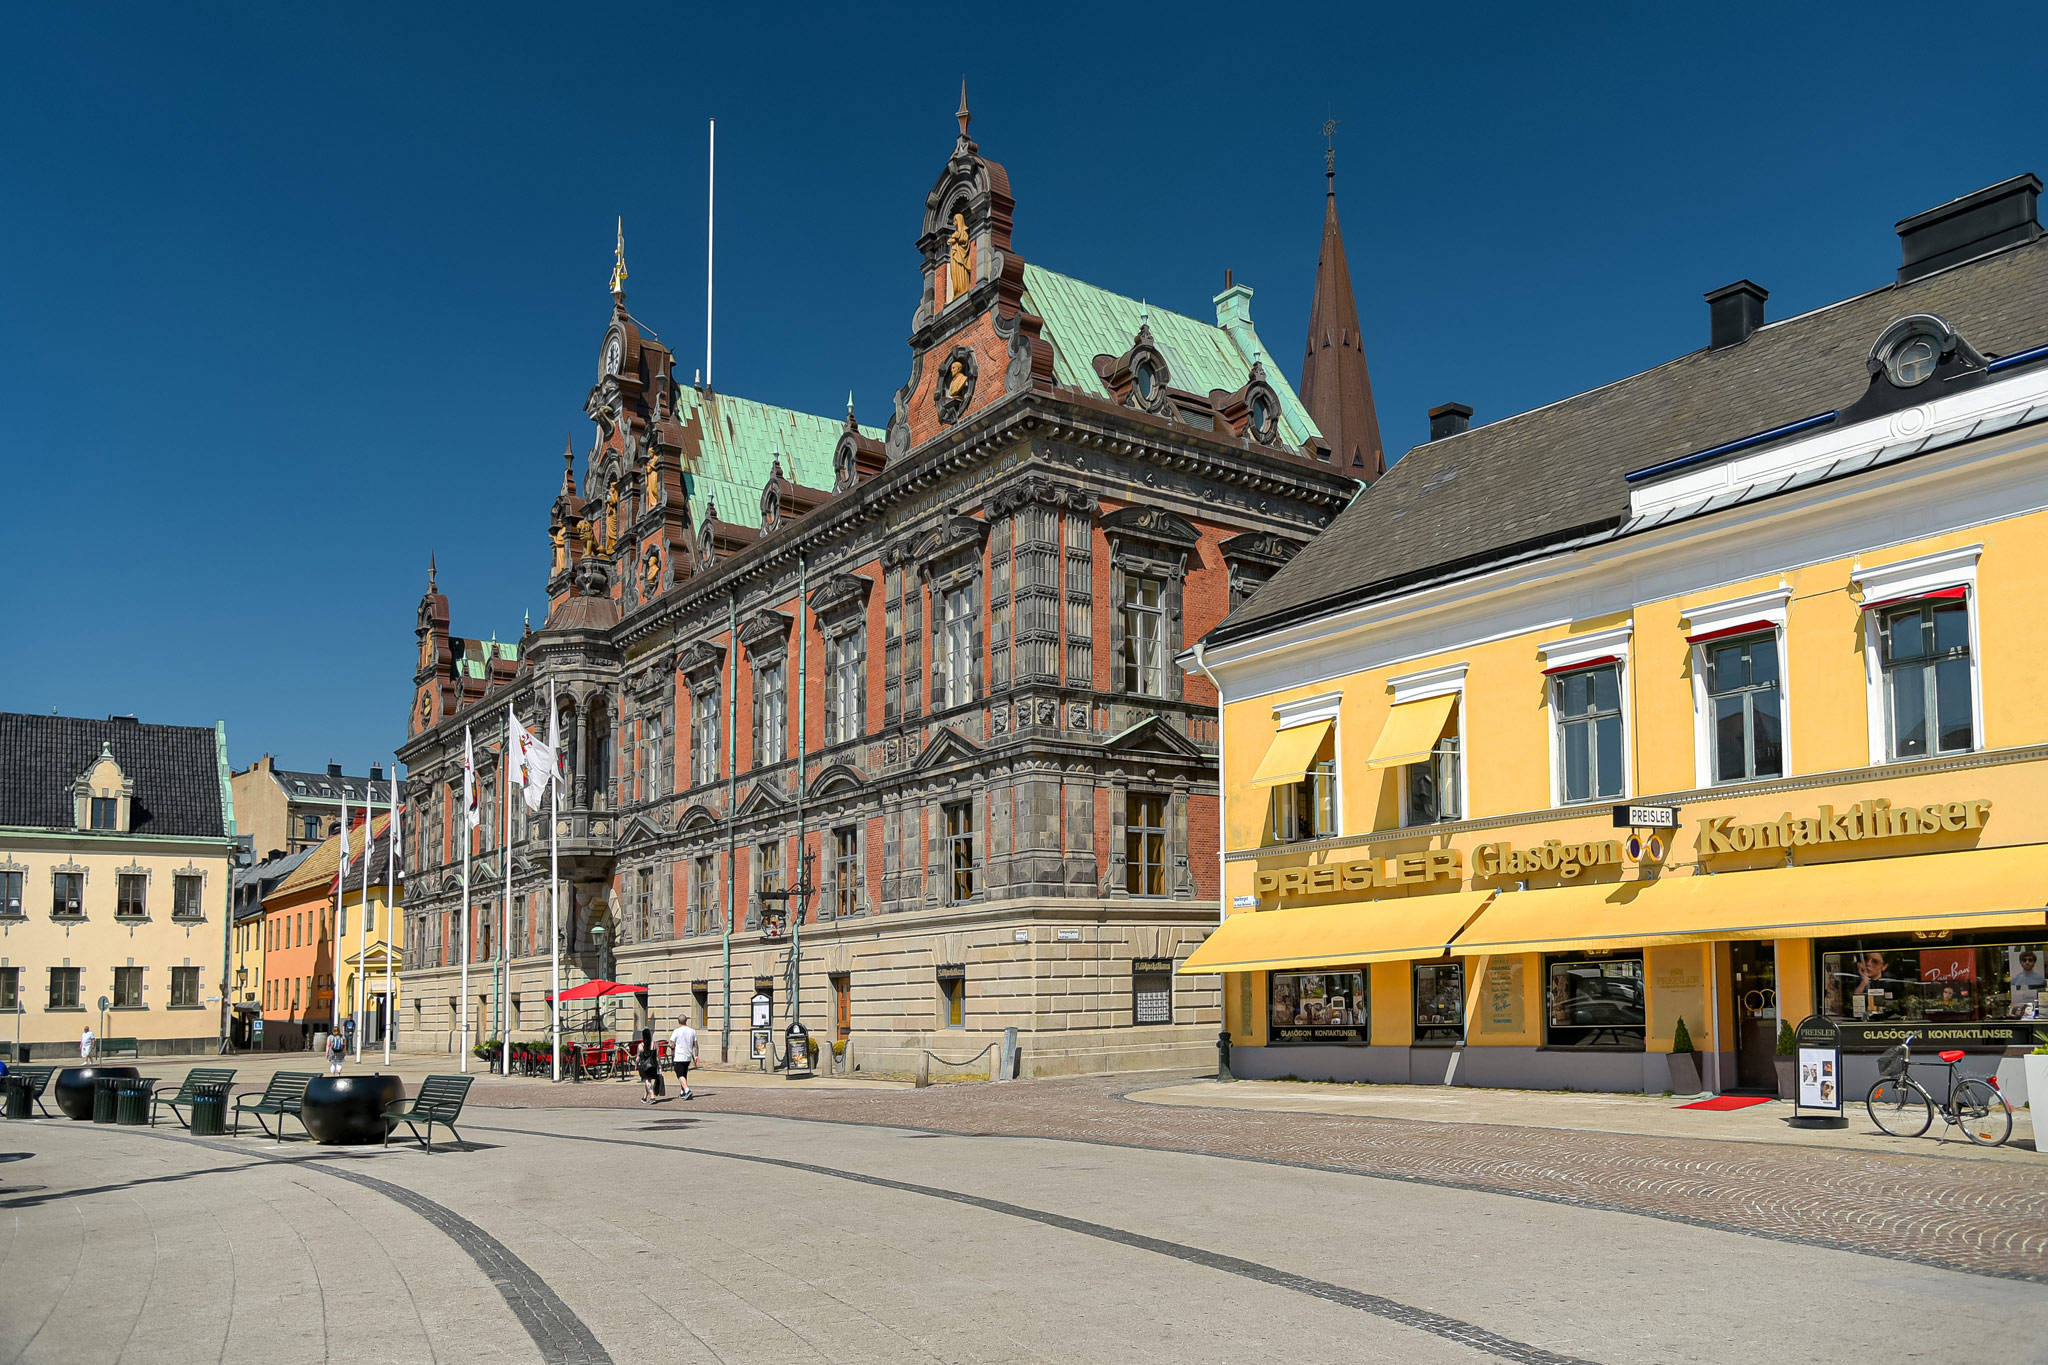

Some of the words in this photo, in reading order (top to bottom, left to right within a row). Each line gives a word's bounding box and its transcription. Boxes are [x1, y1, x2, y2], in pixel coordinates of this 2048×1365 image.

[977, 465, 994, 483] 1864
[1632, 808, 1671, 824] PREISLER
[1254, 849, 1463, 899] PREISLER
[1472, 839, 1624, 879] Glasögon
[1697, 798, 1993, 855] Kontaktlinser
[1925, 961, 1971, 984] Ray-Ban
[1281, 1029, 1312, 1037] GLASÖGON
[1315, 1029, 1357, 1037] KONTAKTLINSER
[1801, 1028, 1837, 1036] PREISLER
[1863, 1028, 1923, 1040] GLASÖGON
[1928, 1029, 2013, 1039] KONTAKTLINSER
